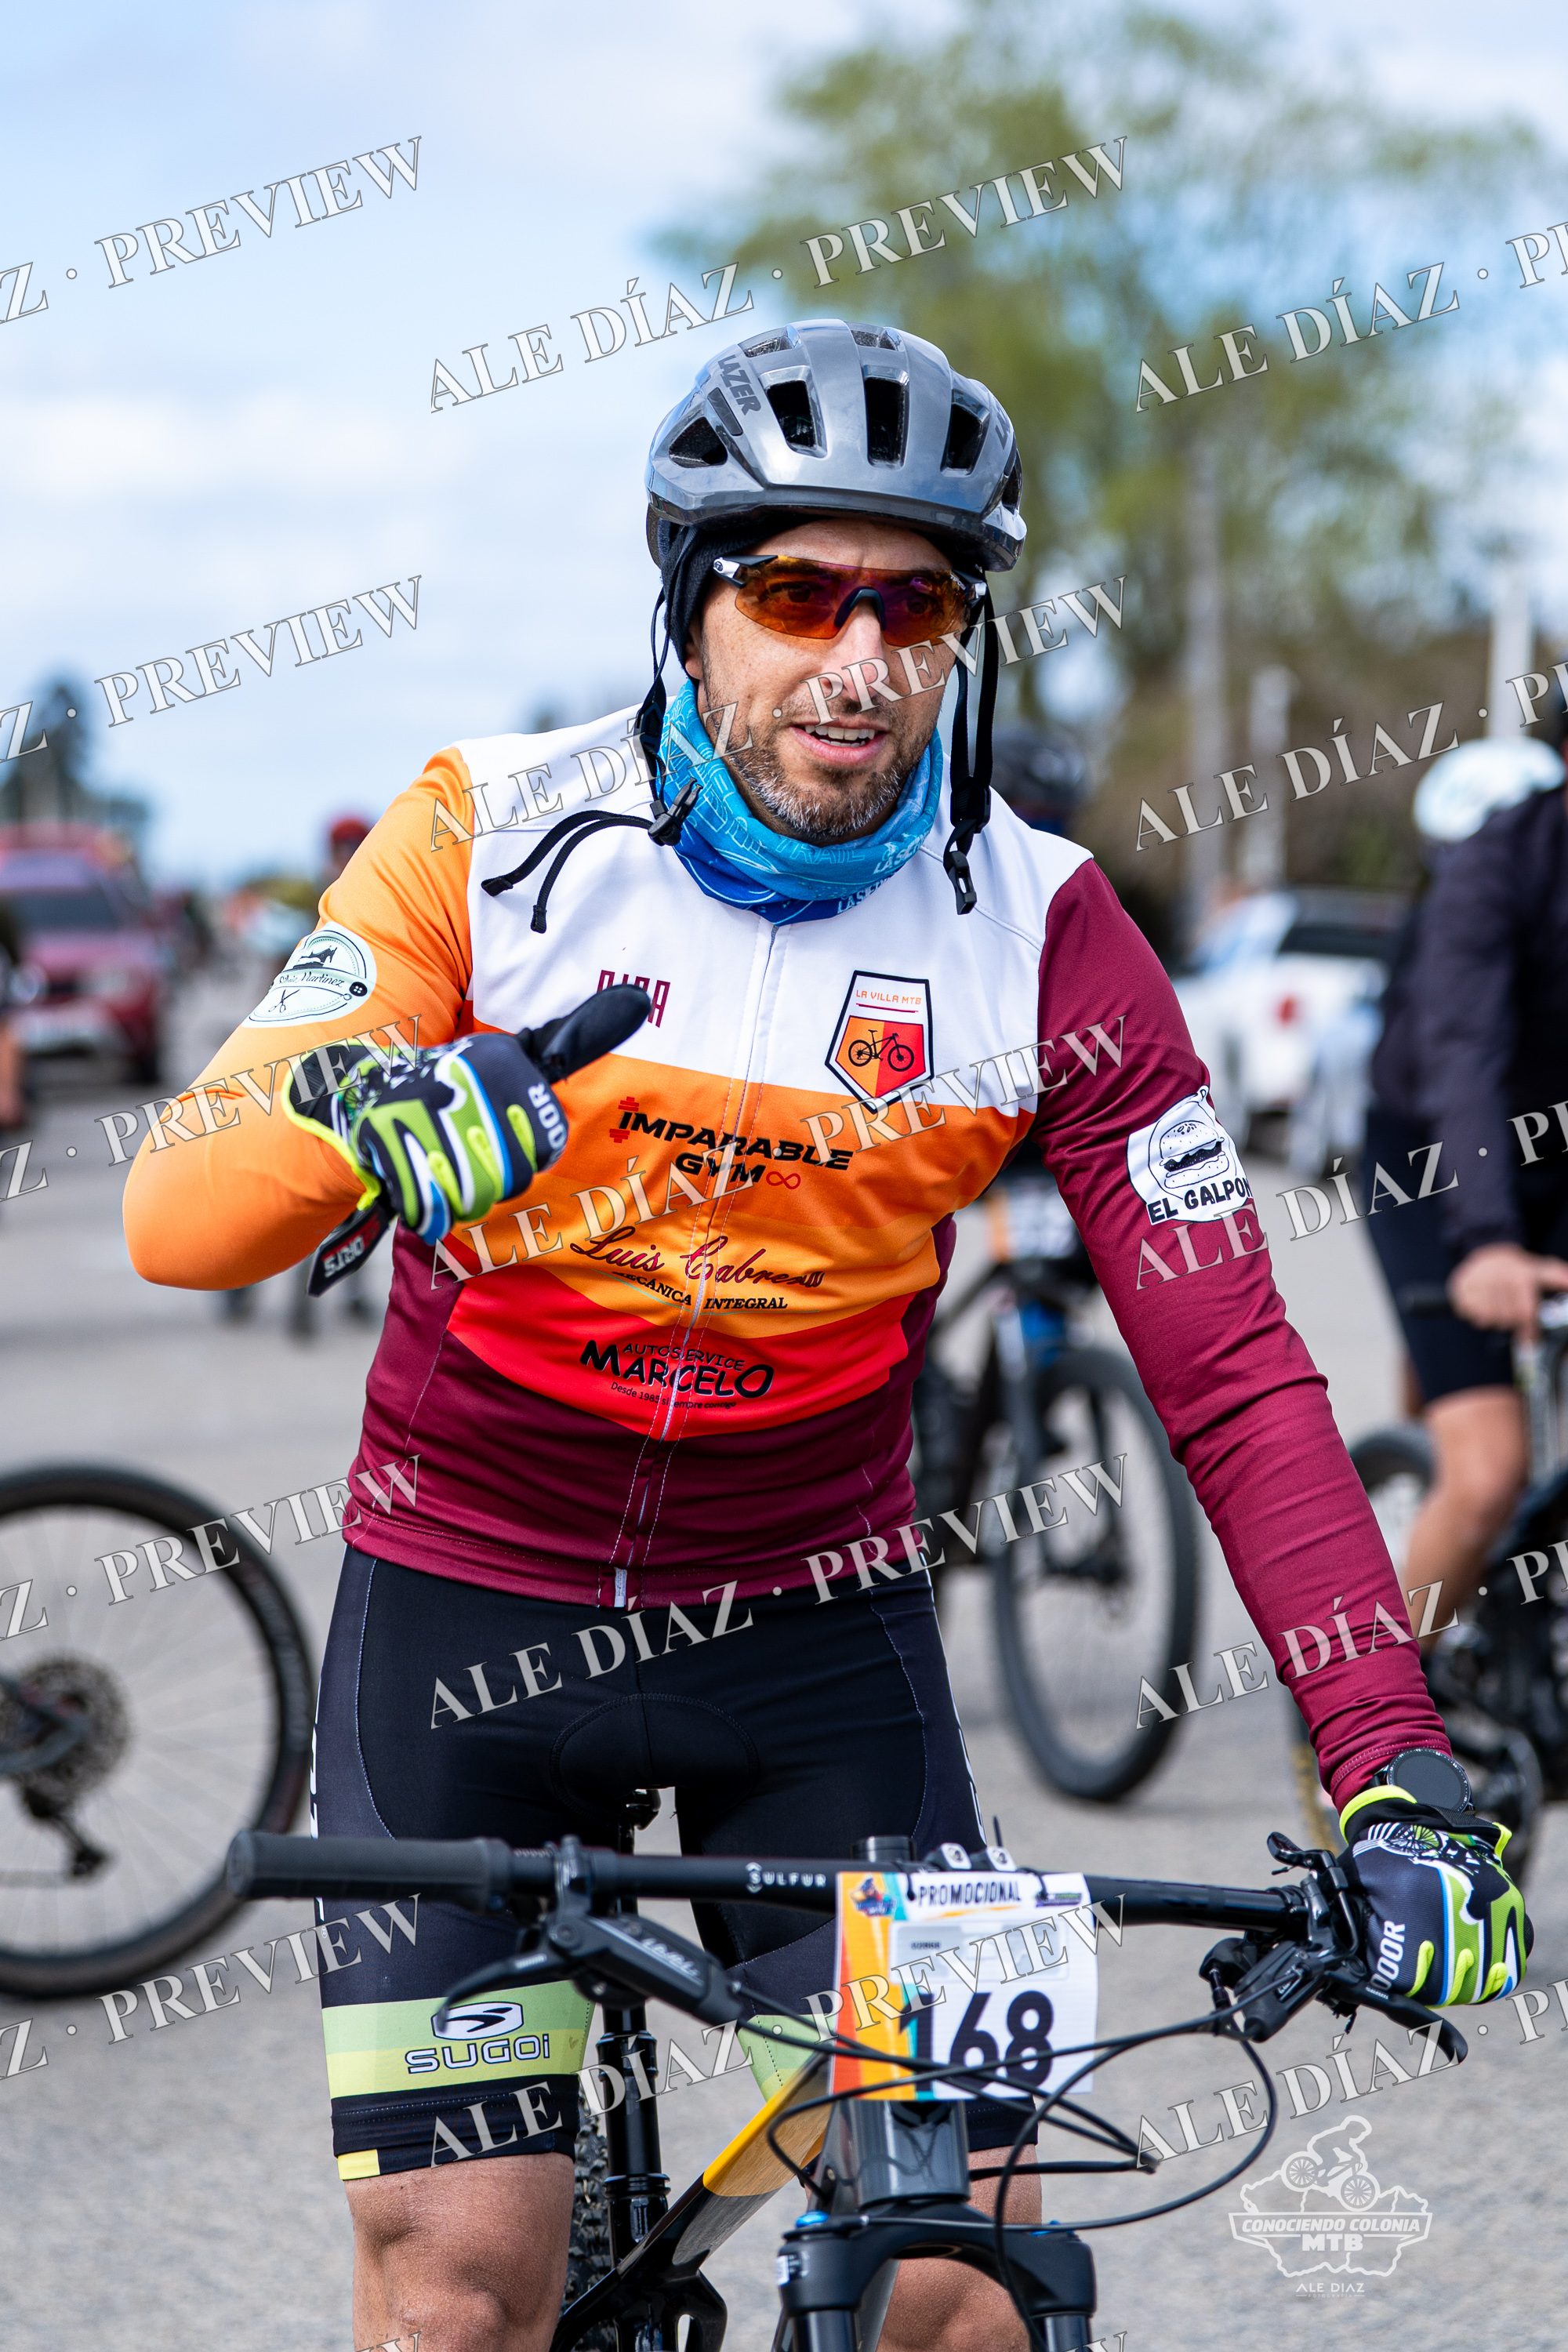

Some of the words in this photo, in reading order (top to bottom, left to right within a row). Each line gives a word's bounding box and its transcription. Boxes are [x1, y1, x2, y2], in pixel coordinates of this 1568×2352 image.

[717, 354, 761, 416] LAZER
[855, 989, 868, 998] LA
[870, 991, 898, 1003] VILLA
[902, 996, 921, 1005] MTB
[528, 1082, 568, 1160] OOR
[618, 1110, 854, 1171] IMPARABLE
[675, 1151, 766, 1183] GYM
[1147, 1197, 1178, 1223] EL
[570, 1225, 665, 1272] Luis
[612, 1272, 691, 1305] ECÁNICA
[703, 1297, 788, 1309] INTEGRAL
[579, 1339, 775, 1399] MARCELO
[622, 1343, 746, 1372] AUTOSERVICE
[611, 1381, 637, 1398] Desde
[639, 1392, 660, 1403] 1985
[750, 1871, 826, 1887] SULFUR
[918, 1881, 1022, 1907] PROMOCIONAL
[898, 1989, 1054, 2092] 168
